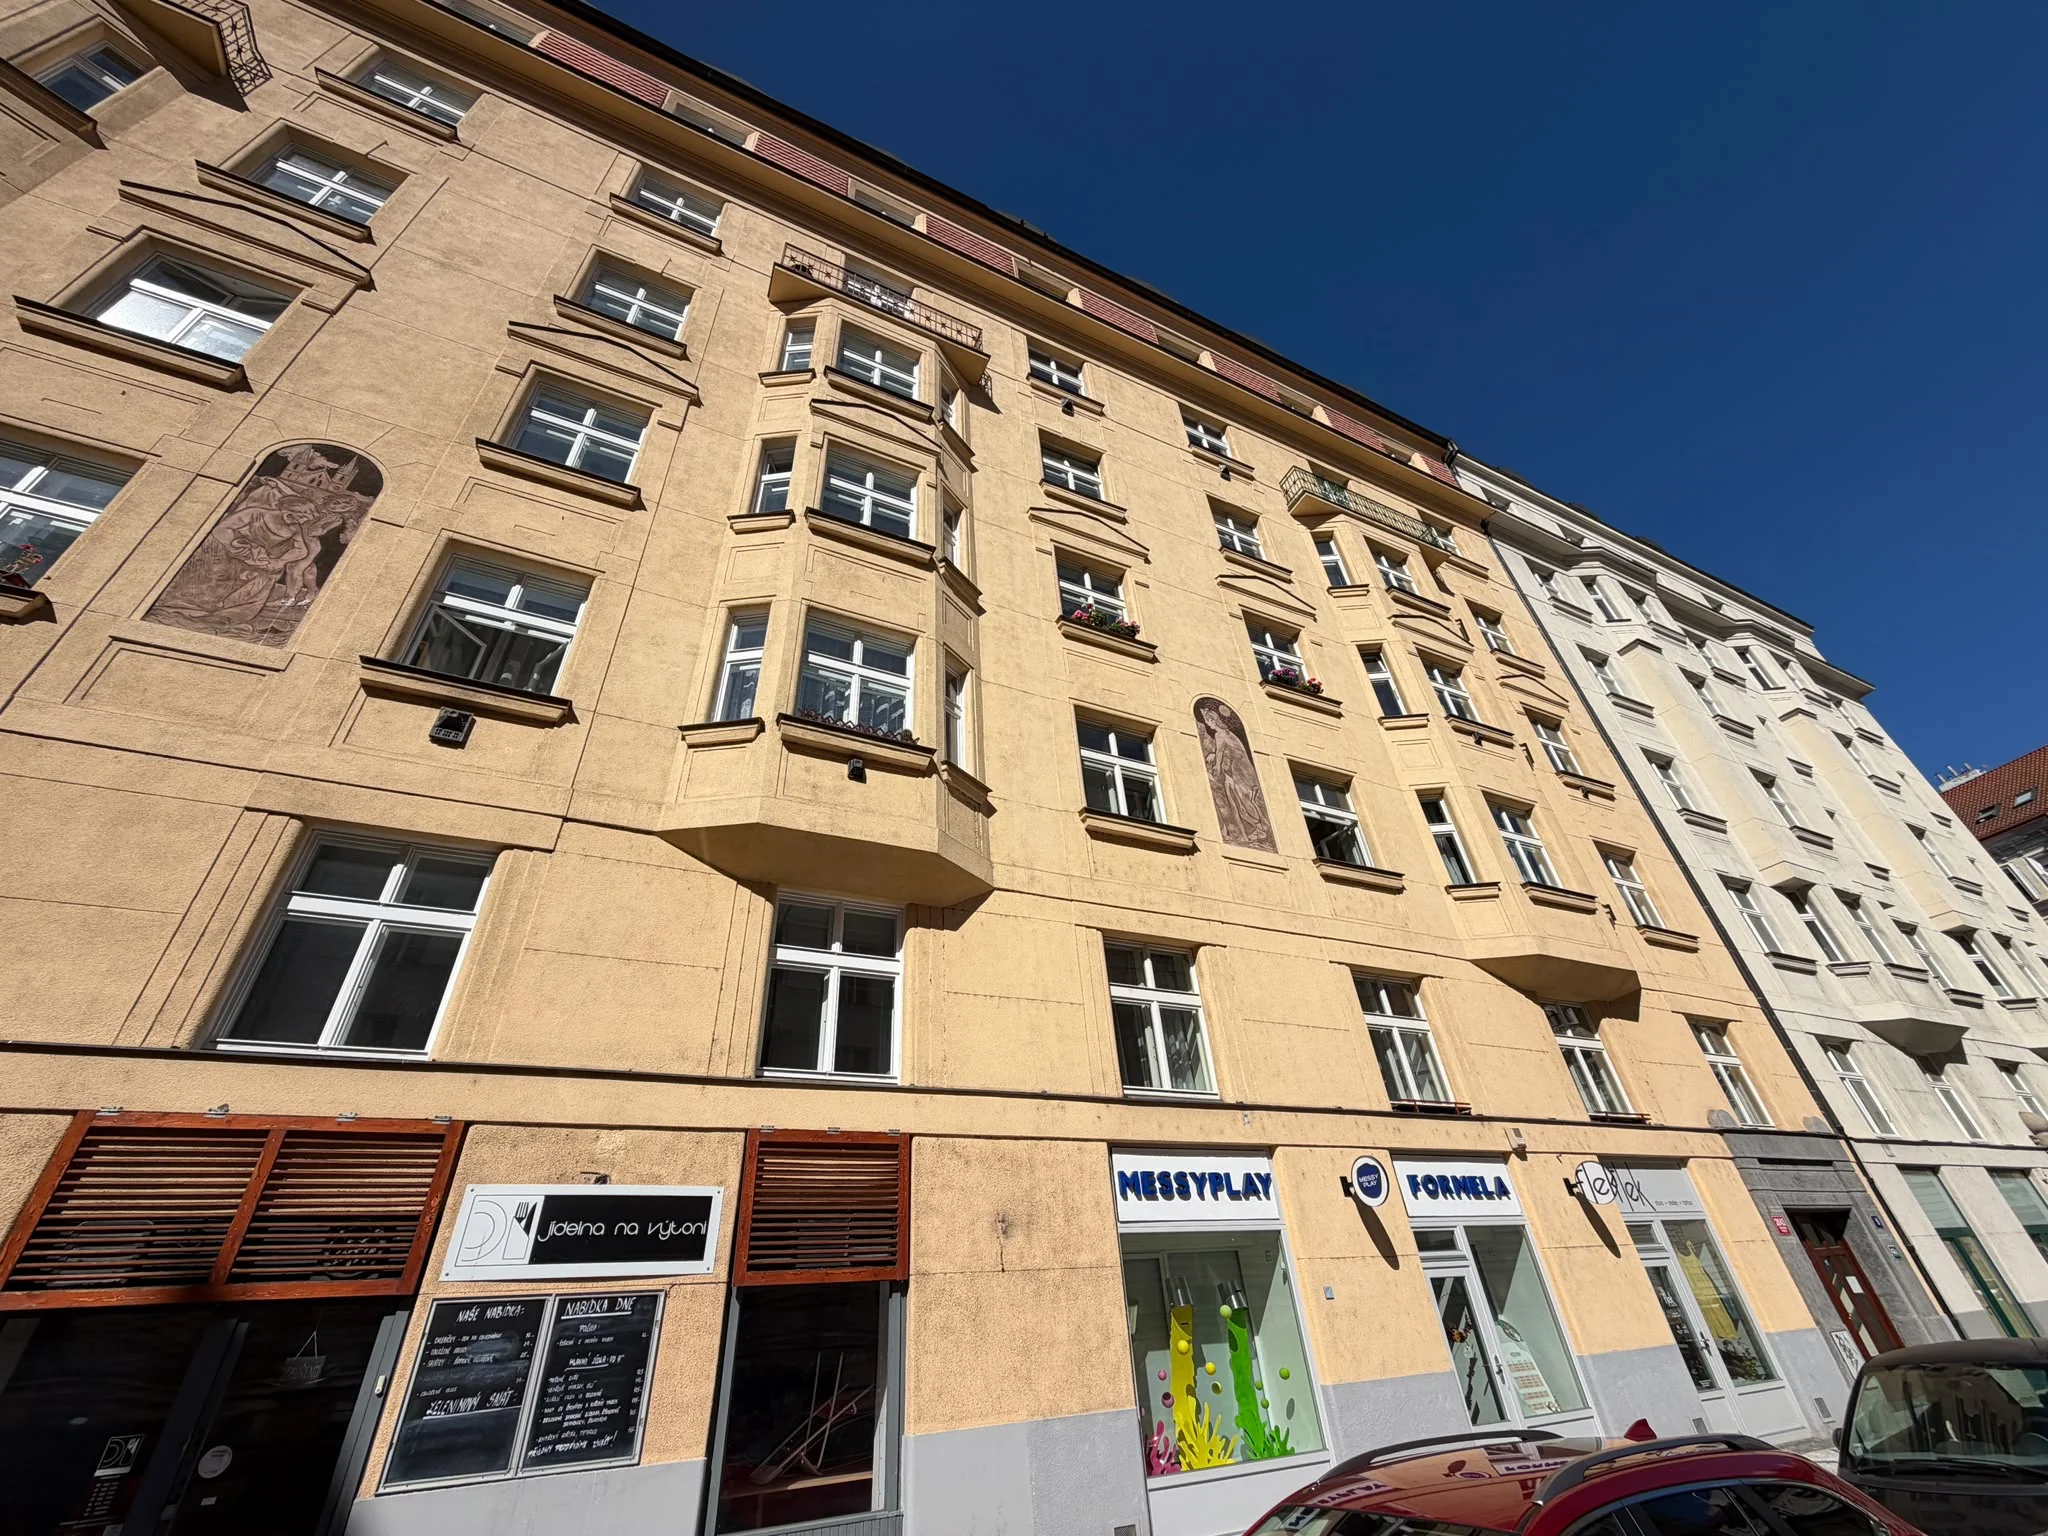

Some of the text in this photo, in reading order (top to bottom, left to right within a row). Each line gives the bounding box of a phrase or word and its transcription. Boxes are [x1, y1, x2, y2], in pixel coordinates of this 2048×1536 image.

[1118, 1169, 1272, 1200] MESSYPLAY
[1358, 1173, 1379, 1183] MESSY
[1363, 1180, 1378, 1188] PLAY
[1406, 1174, 1511, 1201] FORMELA
[538, 1219, 708, 1242] jídelna na výtoni
[615, 1297, 637, 1311] DNE
